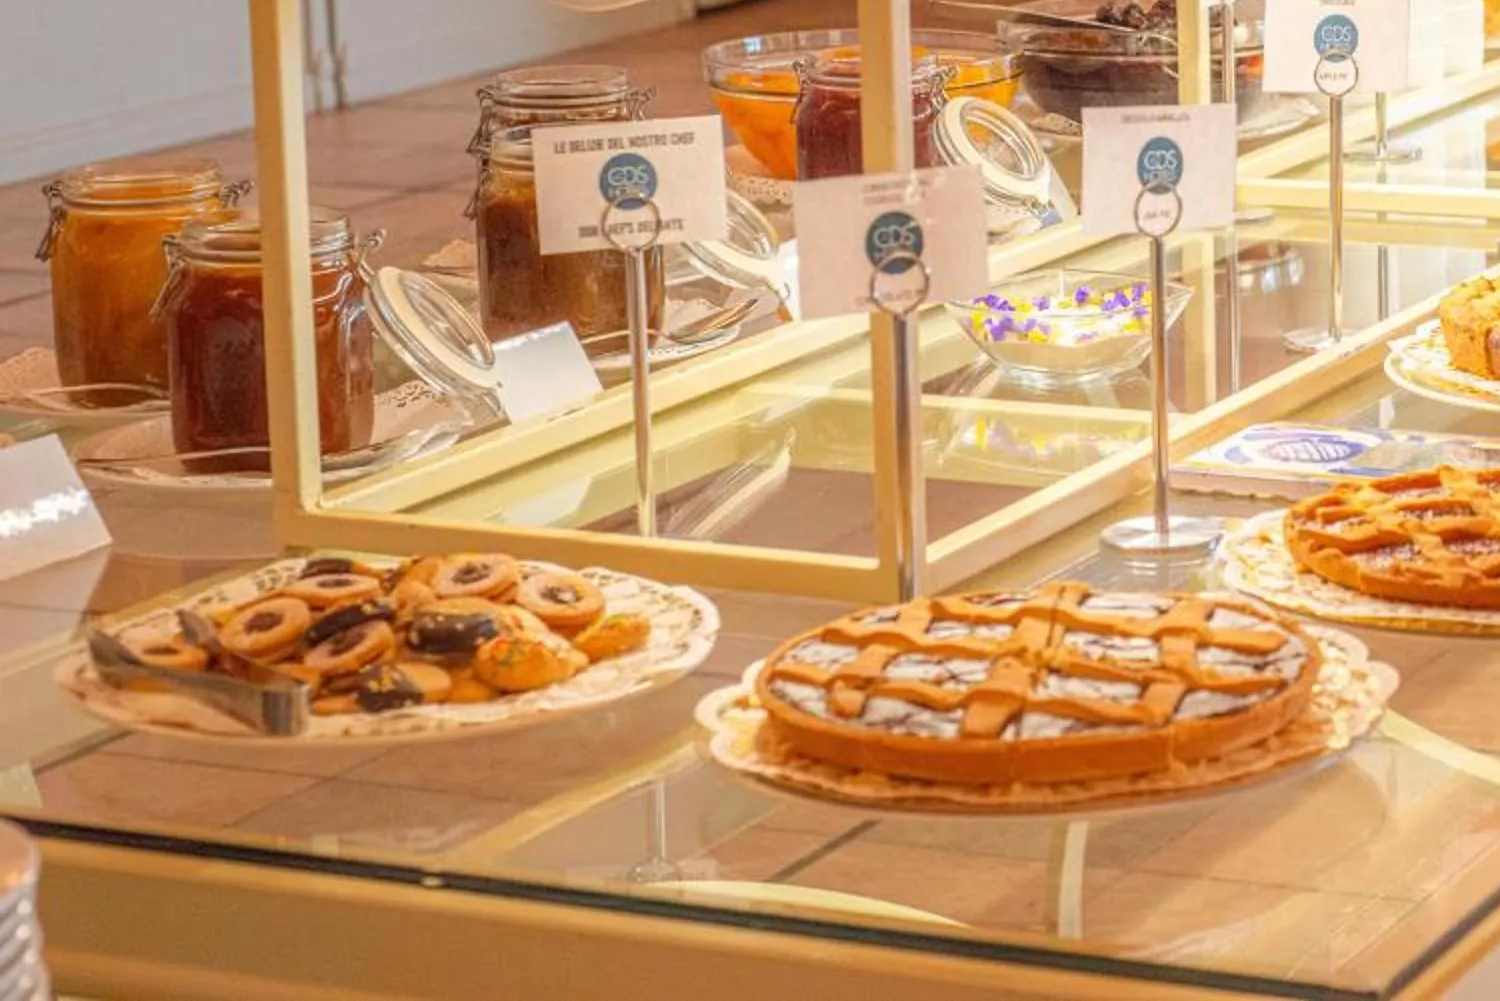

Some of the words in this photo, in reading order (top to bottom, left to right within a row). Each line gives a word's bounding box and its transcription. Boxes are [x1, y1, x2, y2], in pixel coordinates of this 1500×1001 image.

[554, 141, 566, 154] LE
[607, 137, 625, 150] DEL
[629, 134, 667, 148] NOSTRO
[670, 131, 695, 145] CHEF
